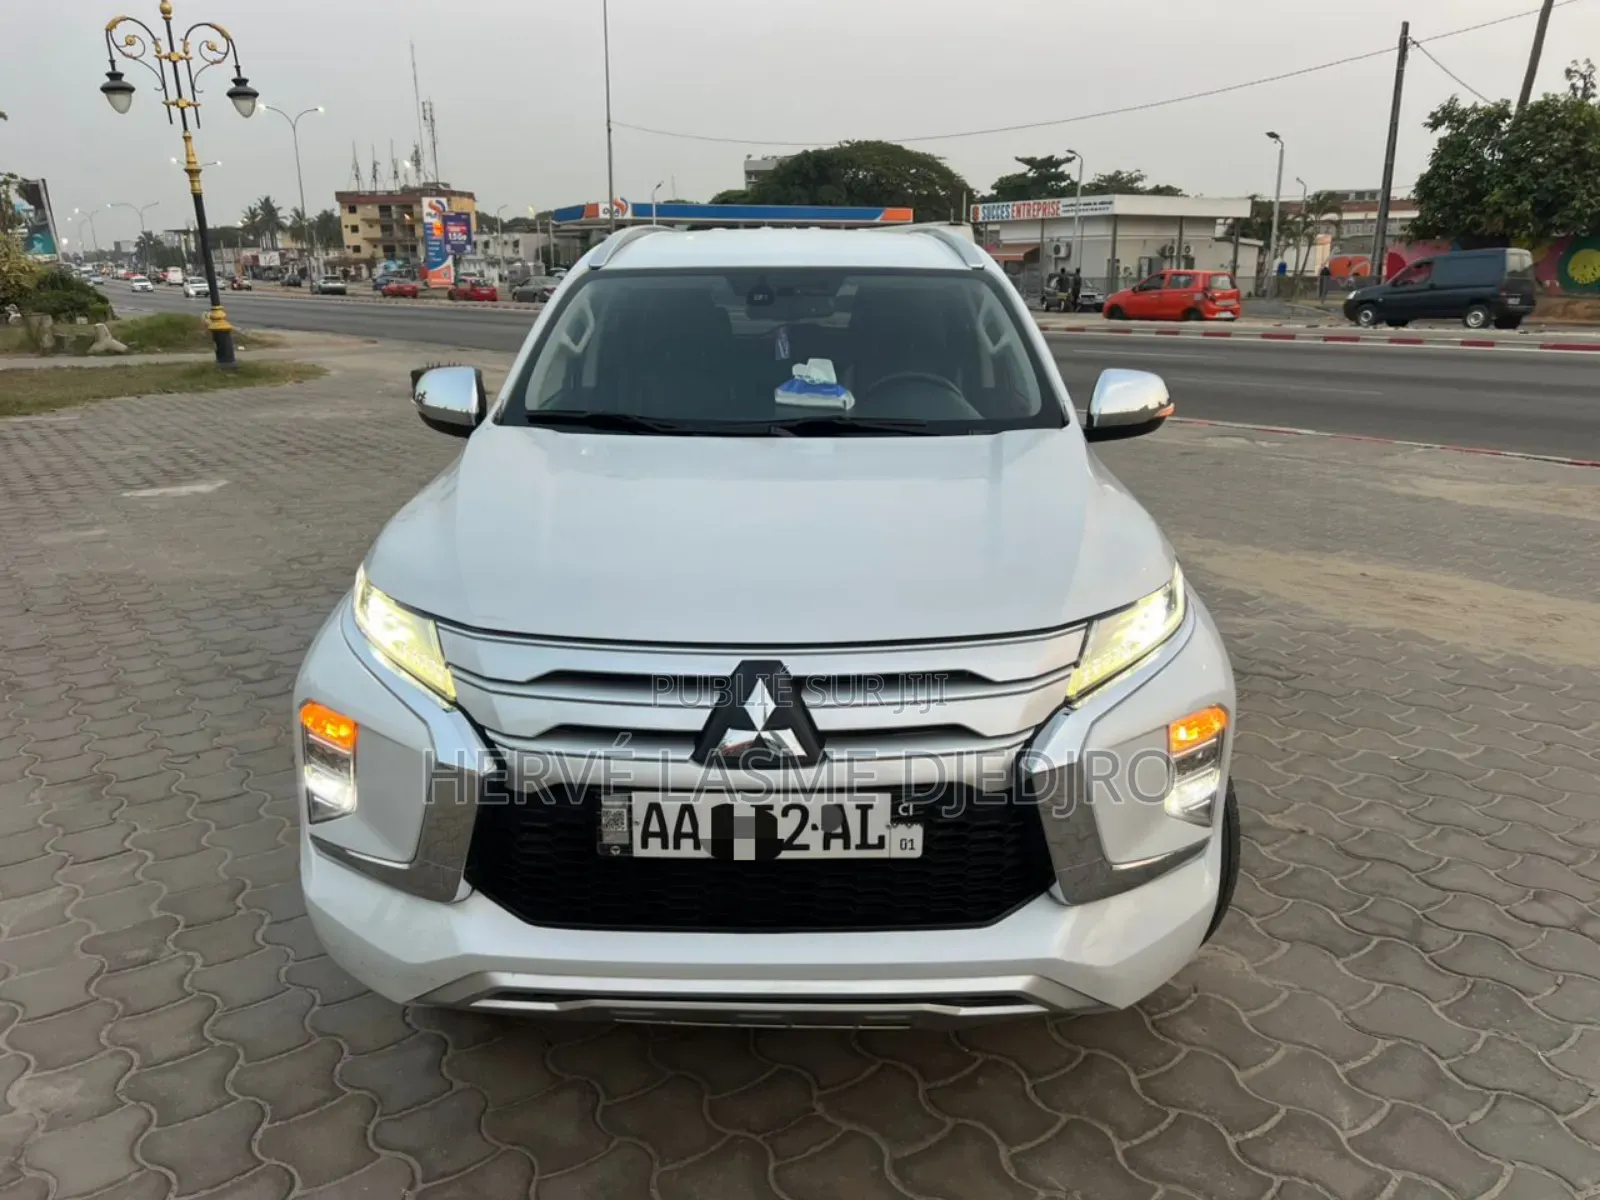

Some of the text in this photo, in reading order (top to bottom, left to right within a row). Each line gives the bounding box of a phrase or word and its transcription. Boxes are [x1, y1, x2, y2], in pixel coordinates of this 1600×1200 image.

[981, 200, 1061, 220] SUCCES ENTREPRISE
[898, 803, 913, 816] CI
[899, 838, 915, 851] 01
